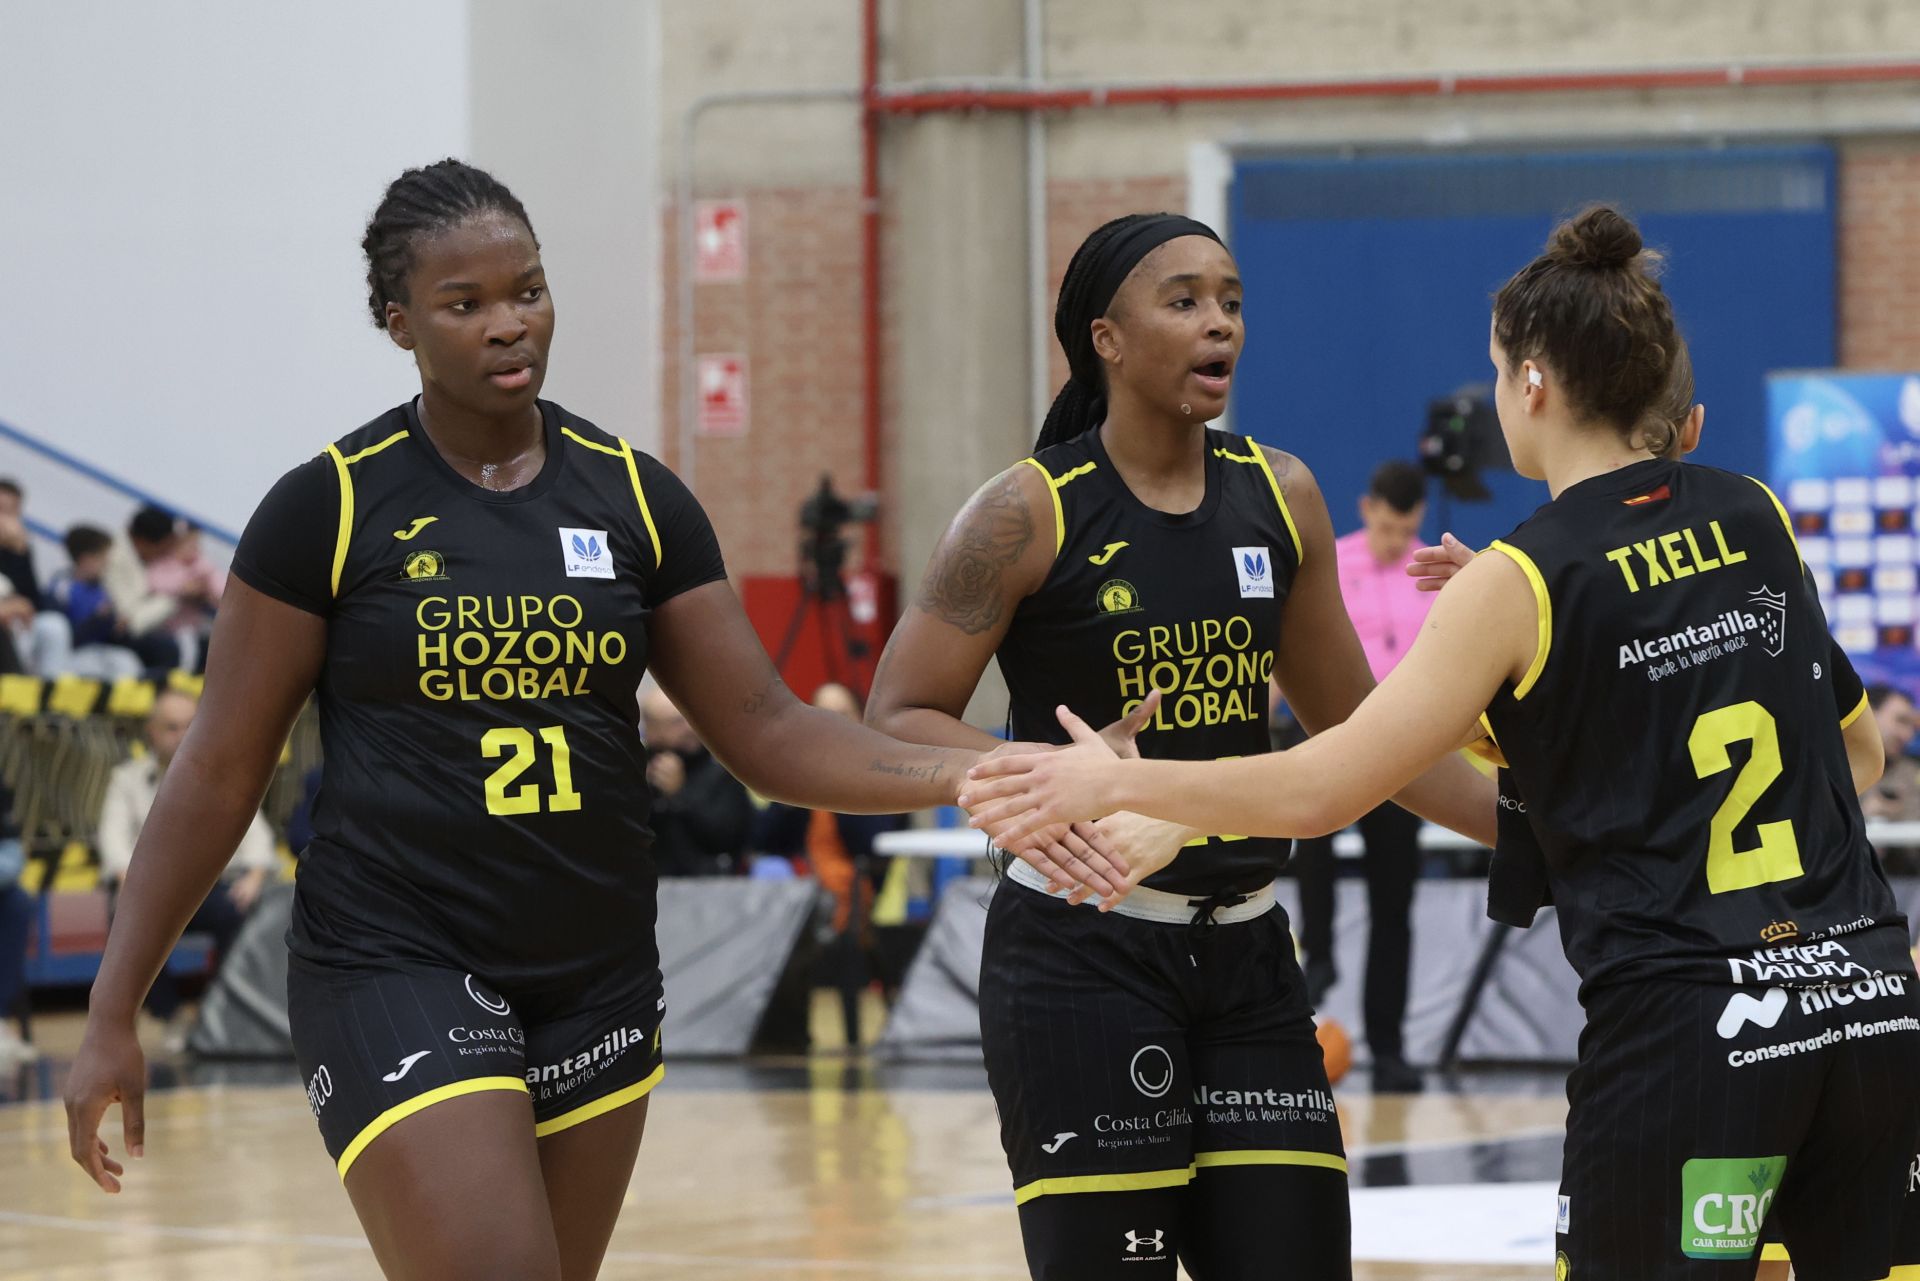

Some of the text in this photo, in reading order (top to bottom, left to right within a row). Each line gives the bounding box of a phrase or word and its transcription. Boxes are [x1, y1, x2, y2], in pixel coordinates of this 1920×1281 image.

[1605, 520, 1748, 593] TXELL
[416, 594, 583, 631] GRUPO
[417, 630, 626, 667] HOZONO
[1113, 615, 1252, 664] GRUPO
[1619, 610, 1758, 669] Alcantarilla
[1117, 650, 1274, 697] HOZONO
[1647, 635, 1749, 682] donde la huerta nace
[419, 667, 591, 701] GLOBAL
[1122, 688, 1259, 732] GLOBAL
[480, 725, 582, 815] 21
[1687, 700, 1804, 895] 2
[1828, 914, 1876, 937] Murcia
[1727, 957, 1871, 984] NATURA
[448, 1027, 508, 1042] Costa
[1844, 1015, 1920, 1041] Momentos
[525, 1026, 644, 1084] antarilla
[540, 1084, 552, 1101] la
[555, 1067, 596, 1095] huerta
[1094, 1107, 1193, 1132] Costa Cálida
[1206, 1106, 1328, 1123] donde la huerta nace
[1097, 1137, 1133, 1149] Región
[1715, 1239, 1749, 1249] RURAL
